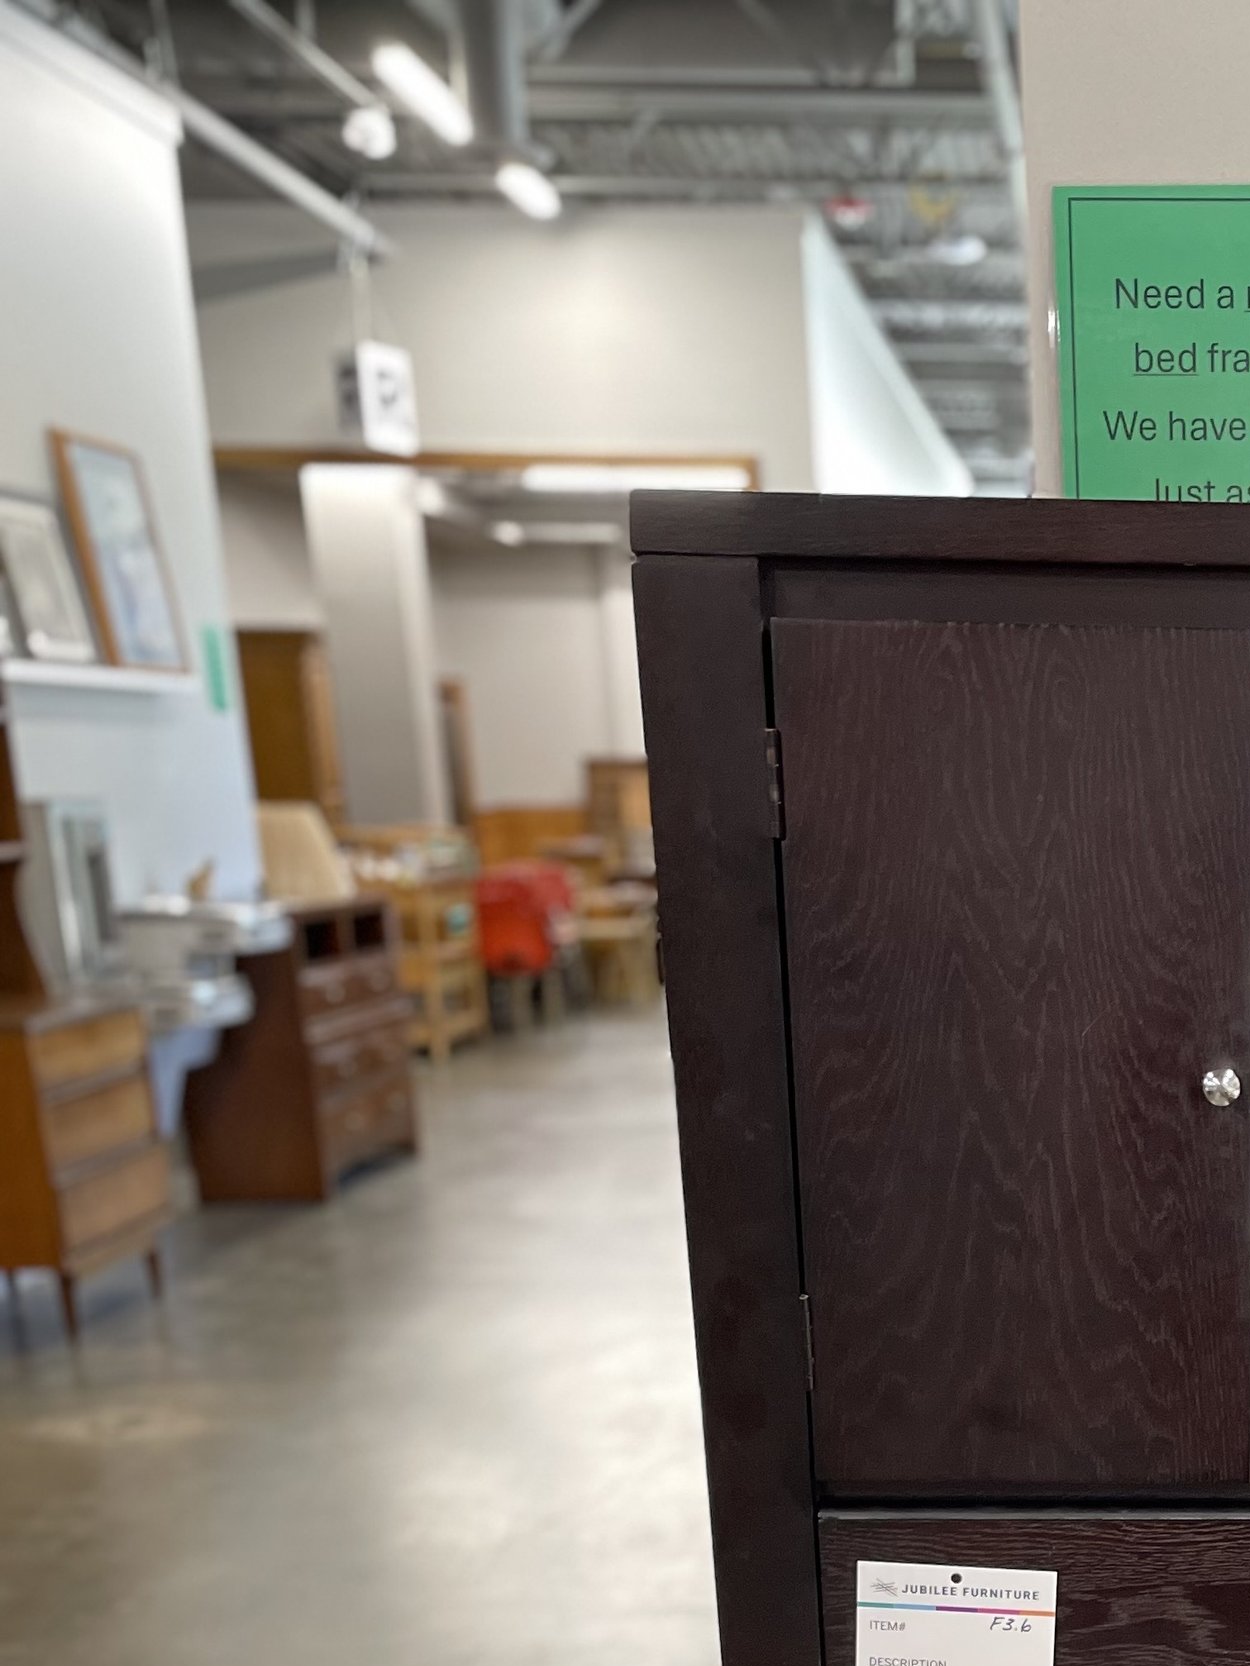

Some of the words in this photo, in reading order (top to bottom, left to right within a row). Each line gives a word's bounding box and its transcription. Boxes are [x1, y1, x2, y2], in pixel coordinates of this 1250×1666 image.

[1115, 278, 1204, 309] Need
[1217, 286, 1234, 309] a
[1135, 343, 1197, 373] bed
[1103, 410, 1156, 441] We
[1169, 411, 1246, 441] have
[902, 1584, 957, 1596] JUBILEE
[963, 1587, 1039, 1600] FURNITURE
[870, 1621, 905, 1631] ITEM#
